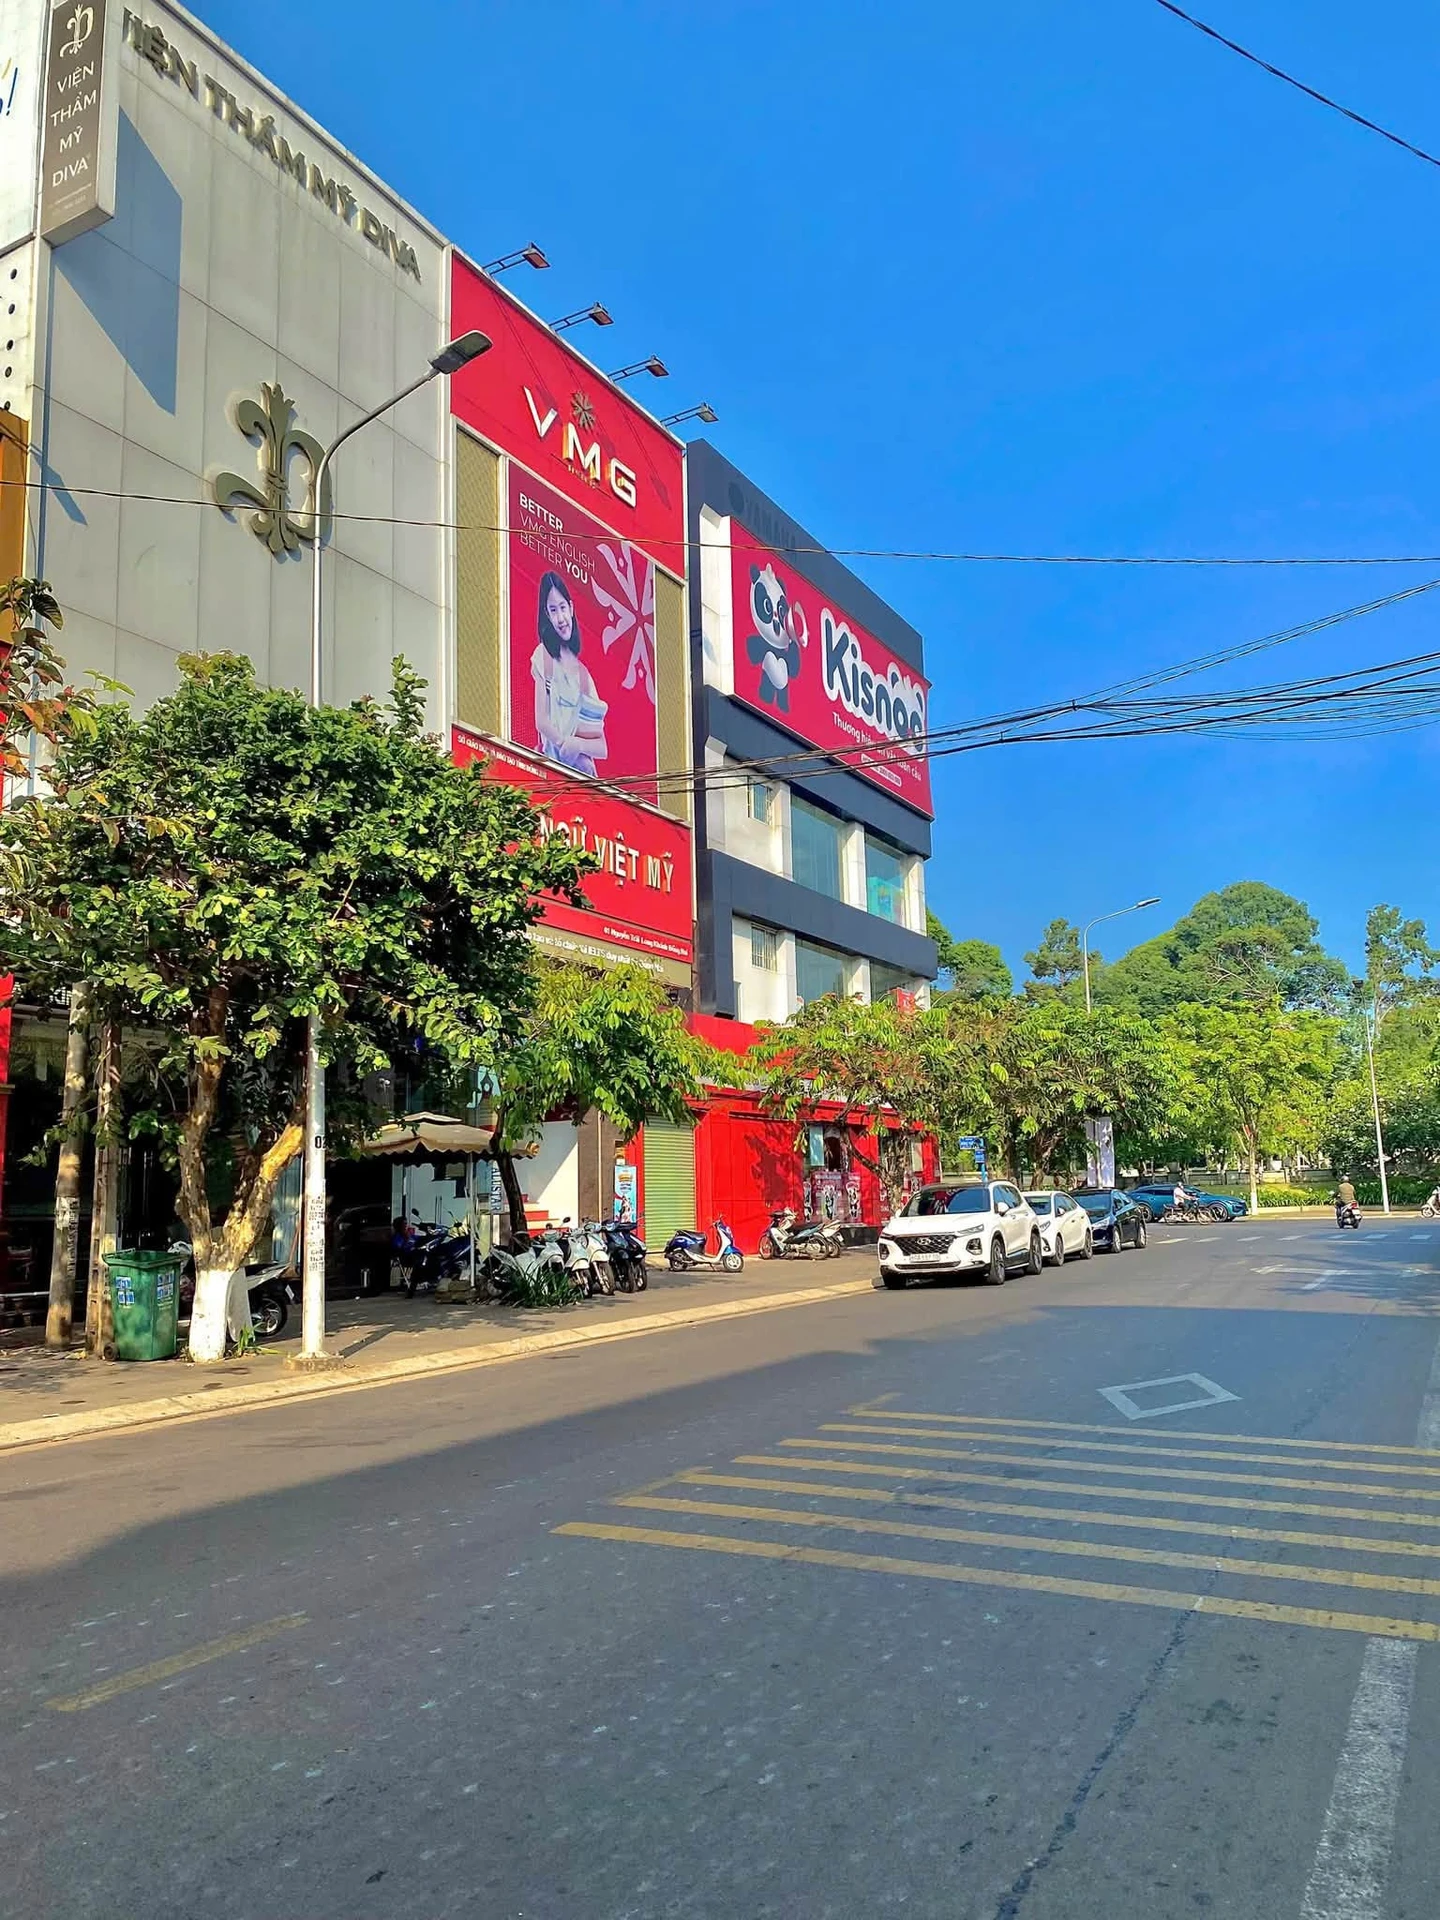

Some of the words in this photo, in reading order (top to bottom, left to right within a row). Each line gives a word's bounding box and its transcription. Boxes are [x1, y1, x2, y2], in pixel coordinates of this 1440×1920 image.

[56, 60, 94, 93] VIỆN
[59, 125, 83, 153] MỸ
[52, 156, 88, 188] DIVA
[357, 206, 422, 284] DIVA
[523, 385, 637, 508] VMG
[519, 492, 563, 533] BETTER
[519, 510, 547, 539] VMG
[549, 532, 595, 572] ENGLISH
[520, 532, 562, 567] BETTER
[564, 558, 588, 585] YOU
[593, 831, 639, 887] VIỆT
[645, 851, 674, 893] MỸ
